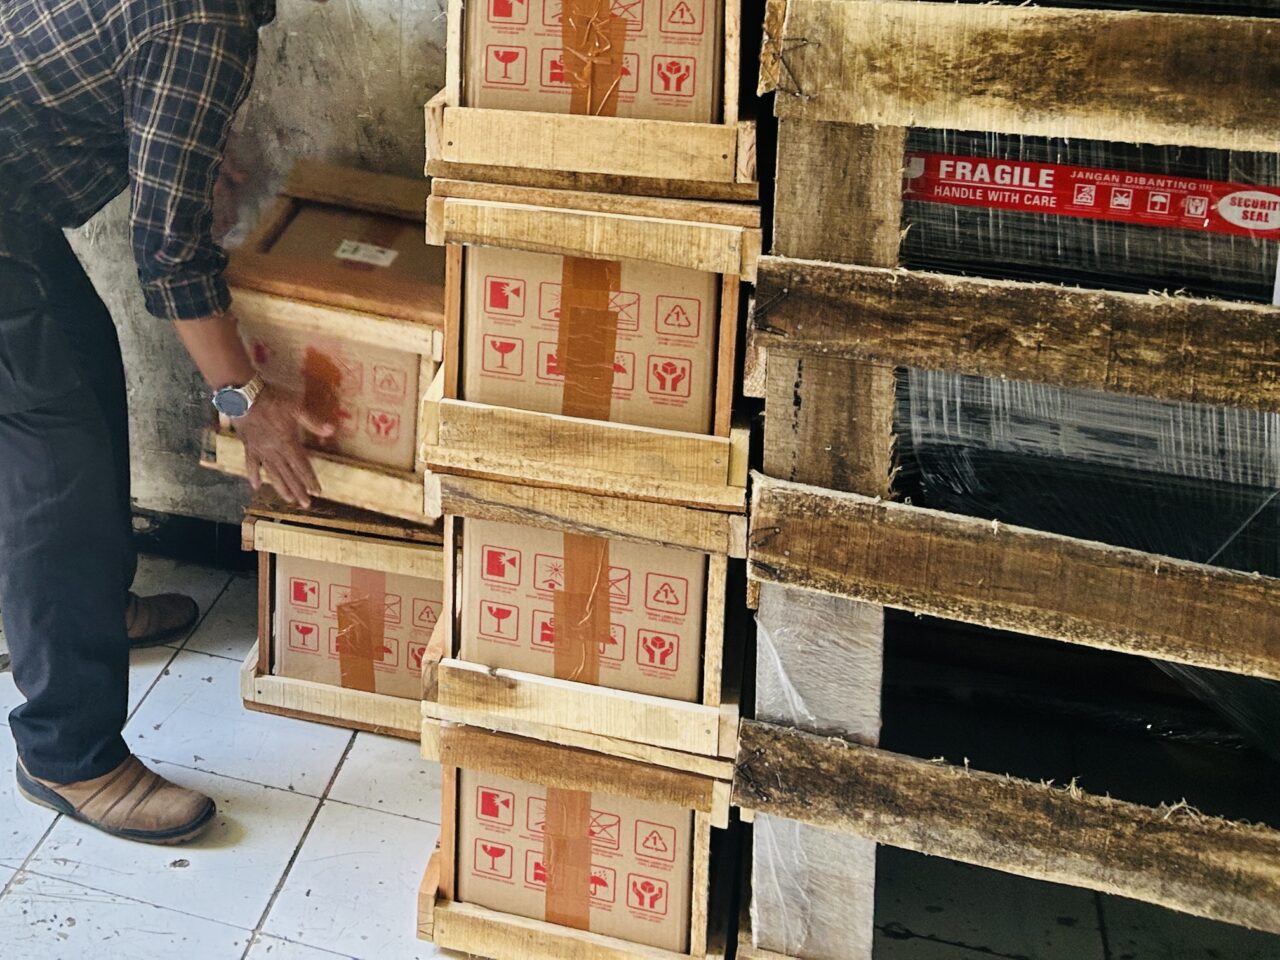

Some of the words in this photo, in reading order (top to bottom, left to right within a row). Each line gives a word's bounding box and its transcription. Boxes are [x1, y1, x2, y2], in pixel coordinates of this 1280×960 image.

[938, 159, 1055, 189] FRAGILE
[1069, 170, 1120, 184] JANGAN
[1124, 175, 1198, 191] DIBANTING
[933, 184, 983, 201] HANDLE
[987, 190, 1020, 205] WITH
[1023, 194, 1057, 208] CARE
[1229, 196, 1280, 212] SECURIT
[1241, 209, 1269, 223] SEAL
